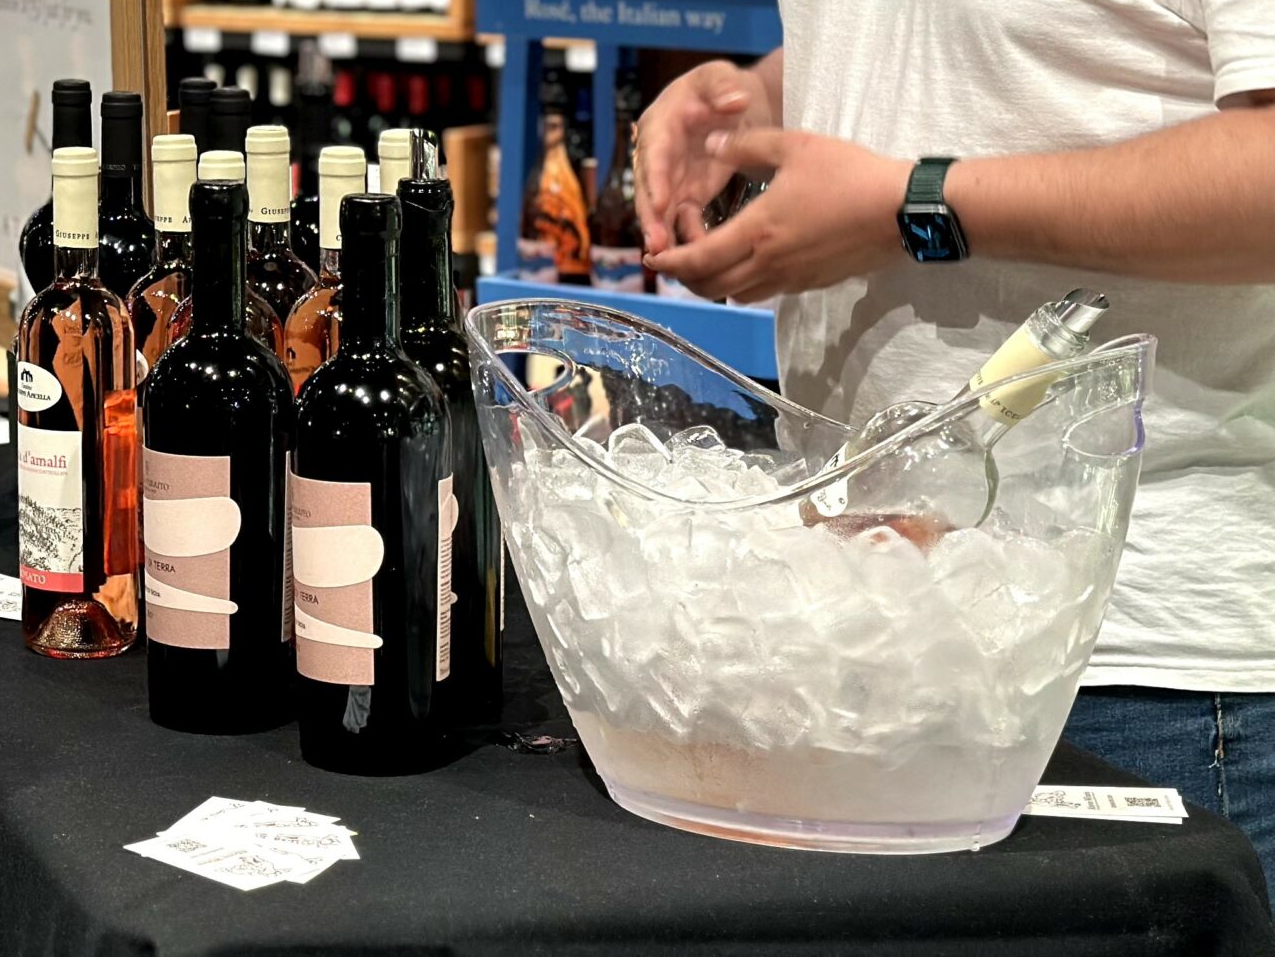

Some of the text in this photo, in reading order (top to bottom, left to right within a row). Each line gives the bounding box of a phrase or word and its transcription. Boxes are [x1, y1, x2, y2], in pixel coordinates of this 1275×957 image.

[580, 0, 613, 23] the
[618, 0, 681, 28] Italian
[686, 12, 726, 34] way
[55, 229, 90, 241] GIUSEPPE
[26, 390, 51, 401] APICELLA
[22, 450, 67, 469] d'amalfi
[153, 560, 176, 573] TERRA
[21, 569, 46, 585] OSATO
[299, 591, 319, 605] TERRA
